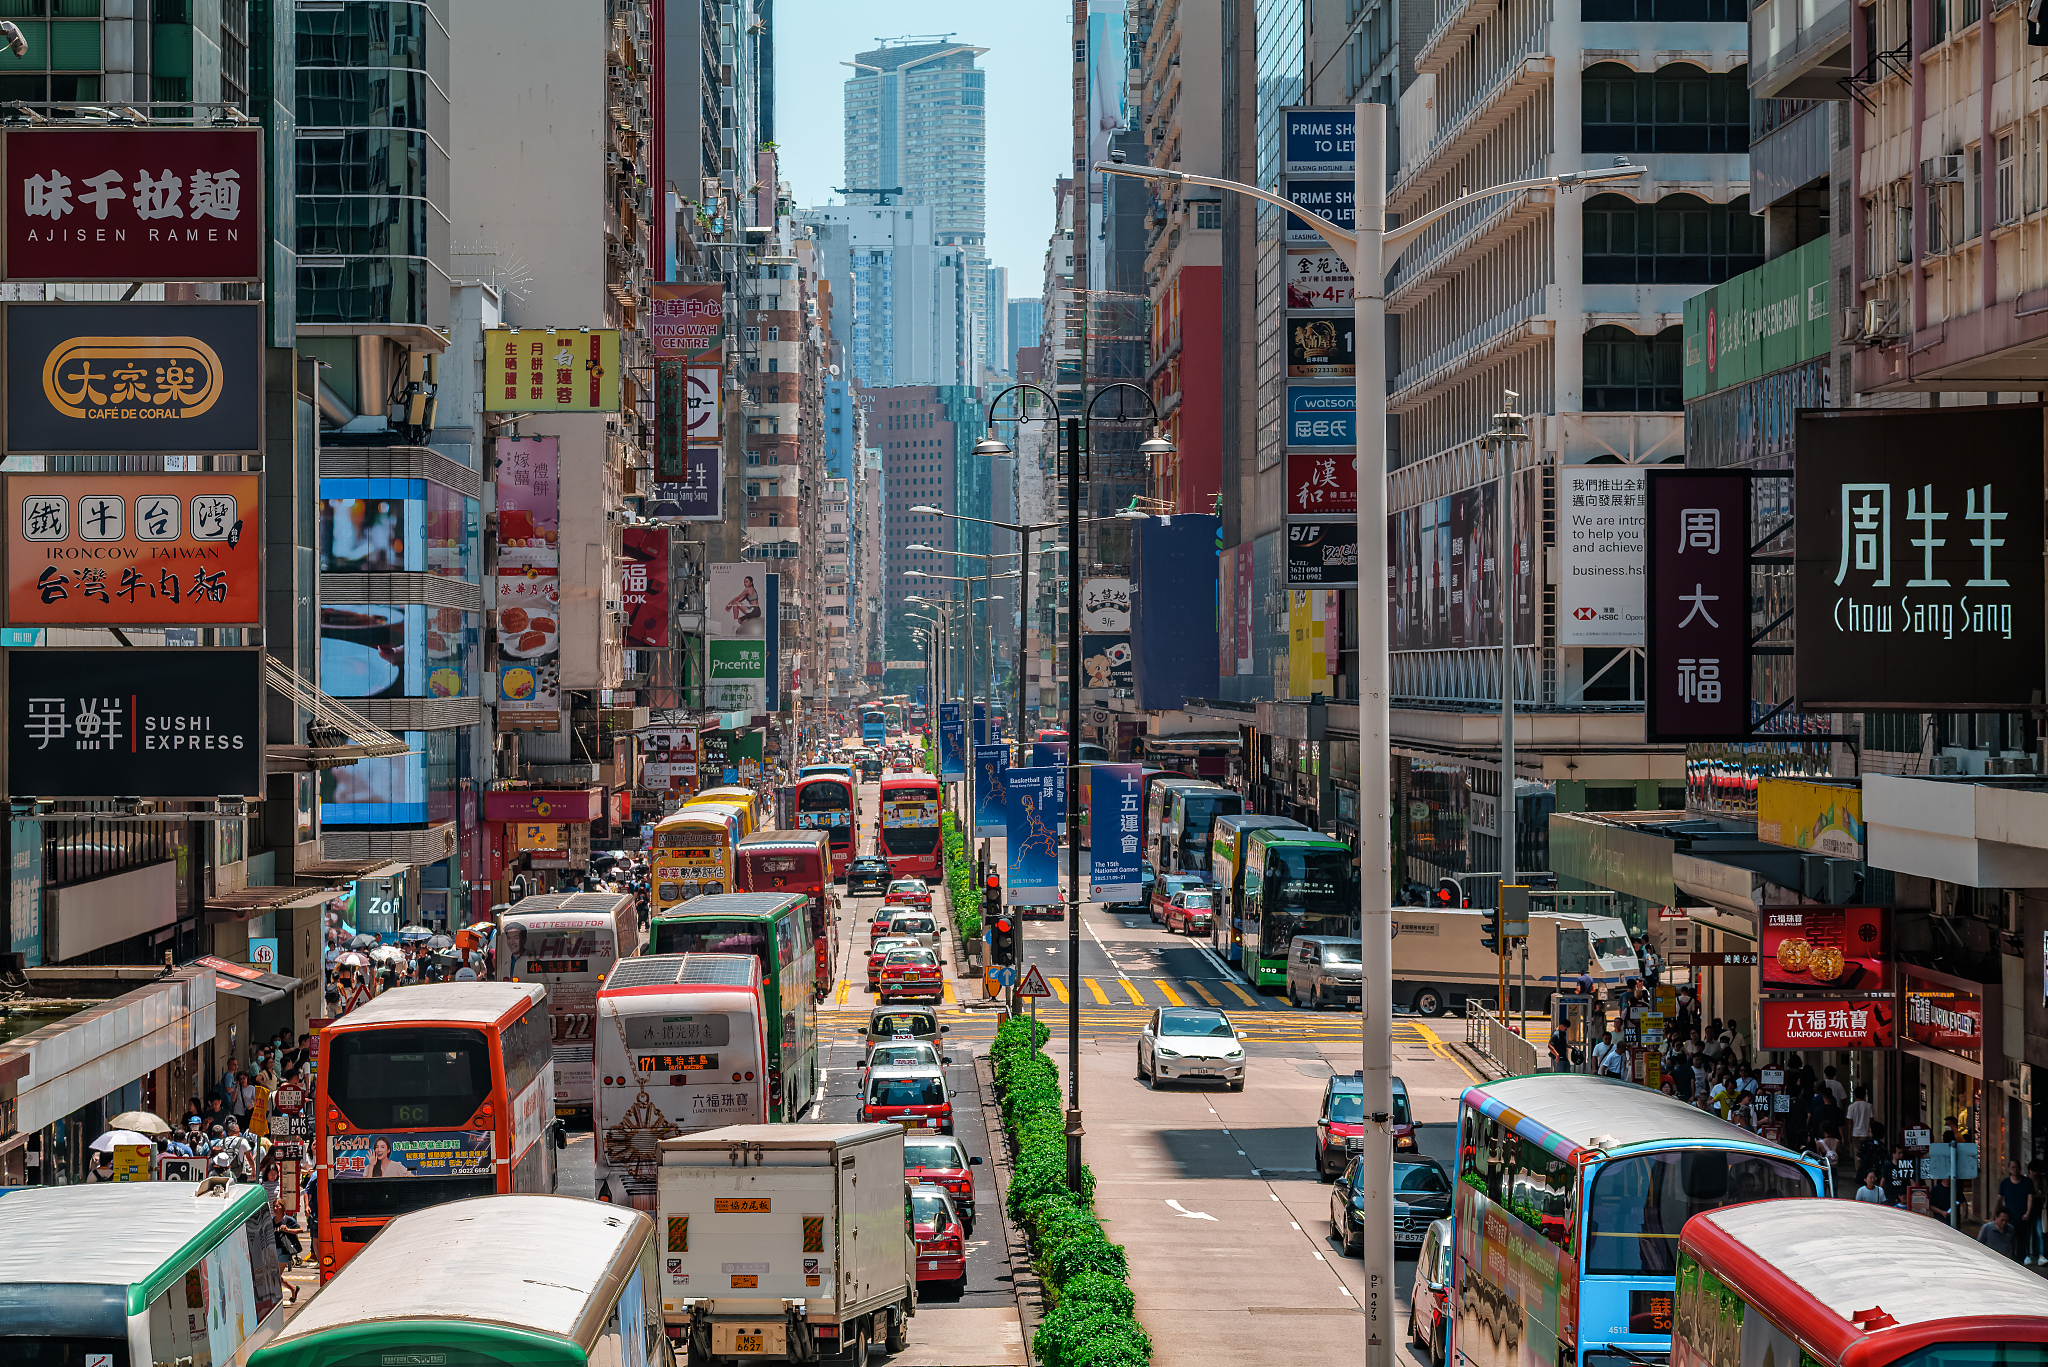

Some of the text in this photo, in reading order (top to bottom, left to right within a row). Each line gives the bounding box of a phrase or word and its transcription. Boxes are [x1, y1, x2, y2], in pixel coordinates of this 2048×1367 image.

[1292, 124, 1355, 135] PRIME SH
[1315, 141, 1332, 152] TO
[24, 169, 241, 221] 味千拉麵
[1292, 192, 1355, 204] PRIME SH
[28, 229, 239, 242] AJISEN RAMEN
[1322, 286, 1345, 303] 4F
[1768, 300, 1783, 337] SENG
[1784, 294, 1799, 330] BANK
[654, 324, 717, 336] KING WAH
[661, 337, 709, 348] CENTRE
[531, 342, 543, 399] 月餅禮餅
[553, 348, 574, 403] 白蓮蓉
[1305, 398, 1356, 408] watsons
[88, 406, 180, 419] CAFÉ DE CORAL
[1295, 420, 1347, 437] 屈臣氏
[680, 490, 693, 502] Sang
[694, 490, 707, 502] Sang
[27, 498, 229, 537] 鐵牛台灣
[1572, 515, 1593, 526] We
[1596, 517, 1615, 526] are
[1290, 526, 1320, 541] 5/F
[1572, 529, 1639, 542] to help you
[1834, 483, 2010, 587] 周生生
[46, 548, 219, 559] IRONCOW TAIWAN
[1572, 543, 1643, 553] and achieve
[37, 565, 228, 604] 台灣牛肉麵
[1678, 508, 1721, 703] 周大福
[1834, 595, 2012, 639] Chow Sang Sang
[713, 660, 761, 670] Pricerite
[145, 716, 211, 731] SUSHI
[145, 735, 244, 750] EXPRESS
[1043, 776, 1054, 797] 籃球
[1121, 772, 1138, 854] 十五運會
[1769, 914, 1803, 923] 六福珠寶
[539, 937, 583, 959] HIV
[1786, 1009, 1868, 1030] 六福珠寶
[1824, 1030, 1867, 1038] JEWELLERY
[640, 1057, 656, 1071] 171
[663, 1055, 708, 1066] 海怡半島
[692, 1093, 748, 1108] 六福珠寶
[400, 1106, 423, 1121] 6C
[291, 1118, 306, 1126] MK
[336, 1156, 366, 1172] 學車
[1898, 1160, 1913, 1168] MK
[1898, 1170, 1914, 1178] 177
[730, 1201, 769, 1210] 協力尾板
[1650, 1297, 1671, 1316] 蘇
[1653, 1316, 1672, 1329] So
[1608, 1326, 1628, 1334] 4513
[744, 1336, 755, 1344] MS
